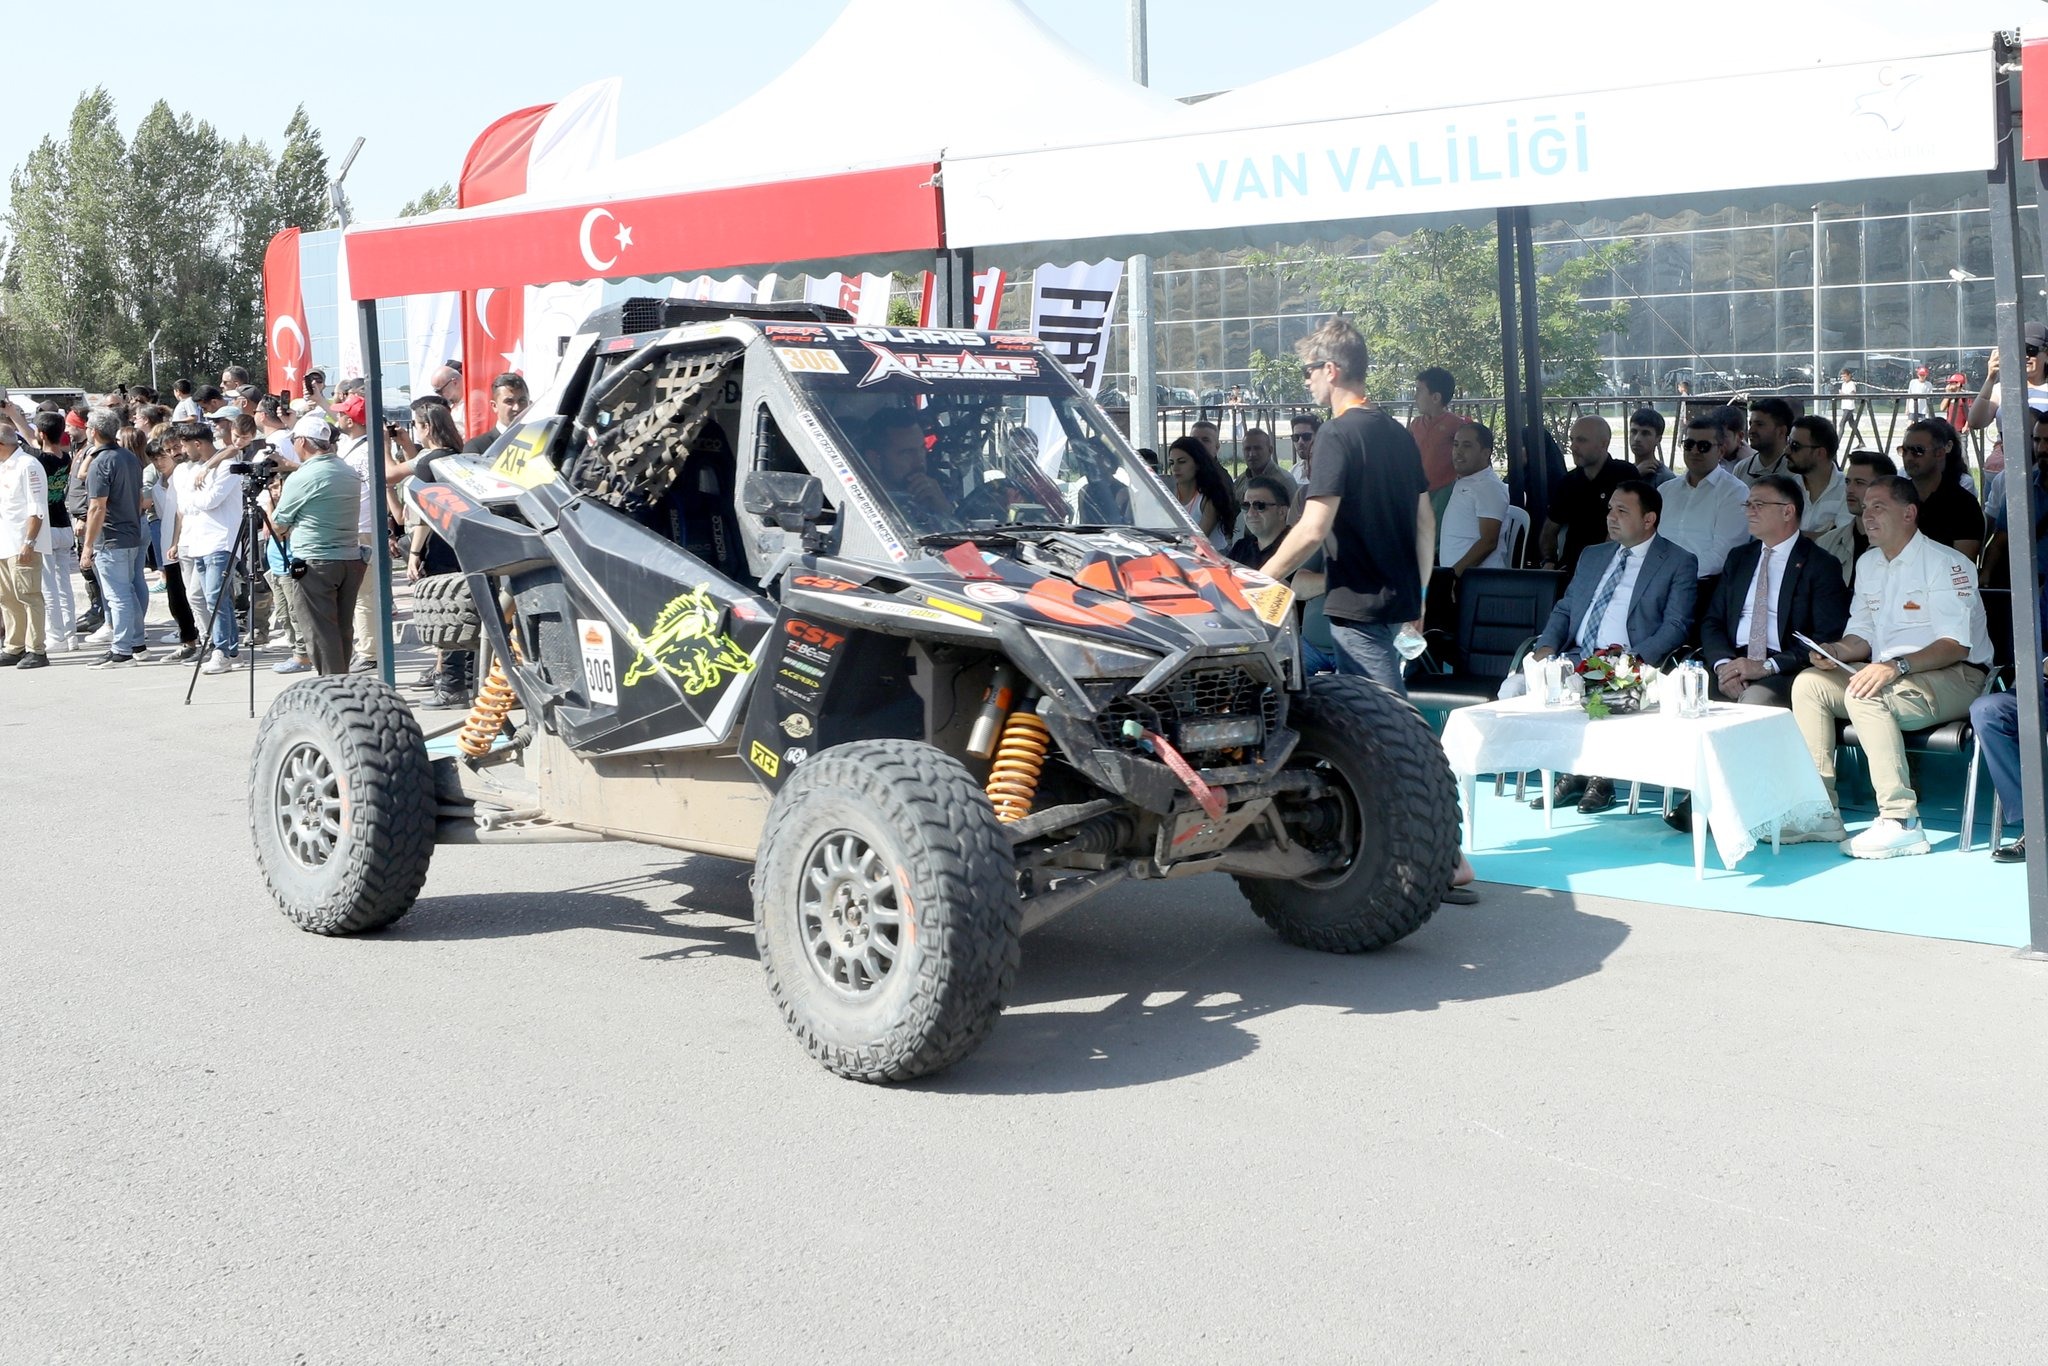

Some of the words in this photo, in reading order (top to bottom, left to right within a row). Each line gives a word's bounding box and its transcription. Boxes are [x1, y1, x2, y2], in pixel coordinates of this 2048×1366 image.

[1196, 152, 1308, 203] VAN
[1327, 112, 1589, 192] VALİLİĞİ
[826, 326, 986, 346] POLARIS
[783, 349, 839, 371] 306
[857, 340, 1041, 388] ALSACE
[792, 575, 860, 592] CST
[784, 619, 846, 649] CST
[586, 657, 613, 694] 306
